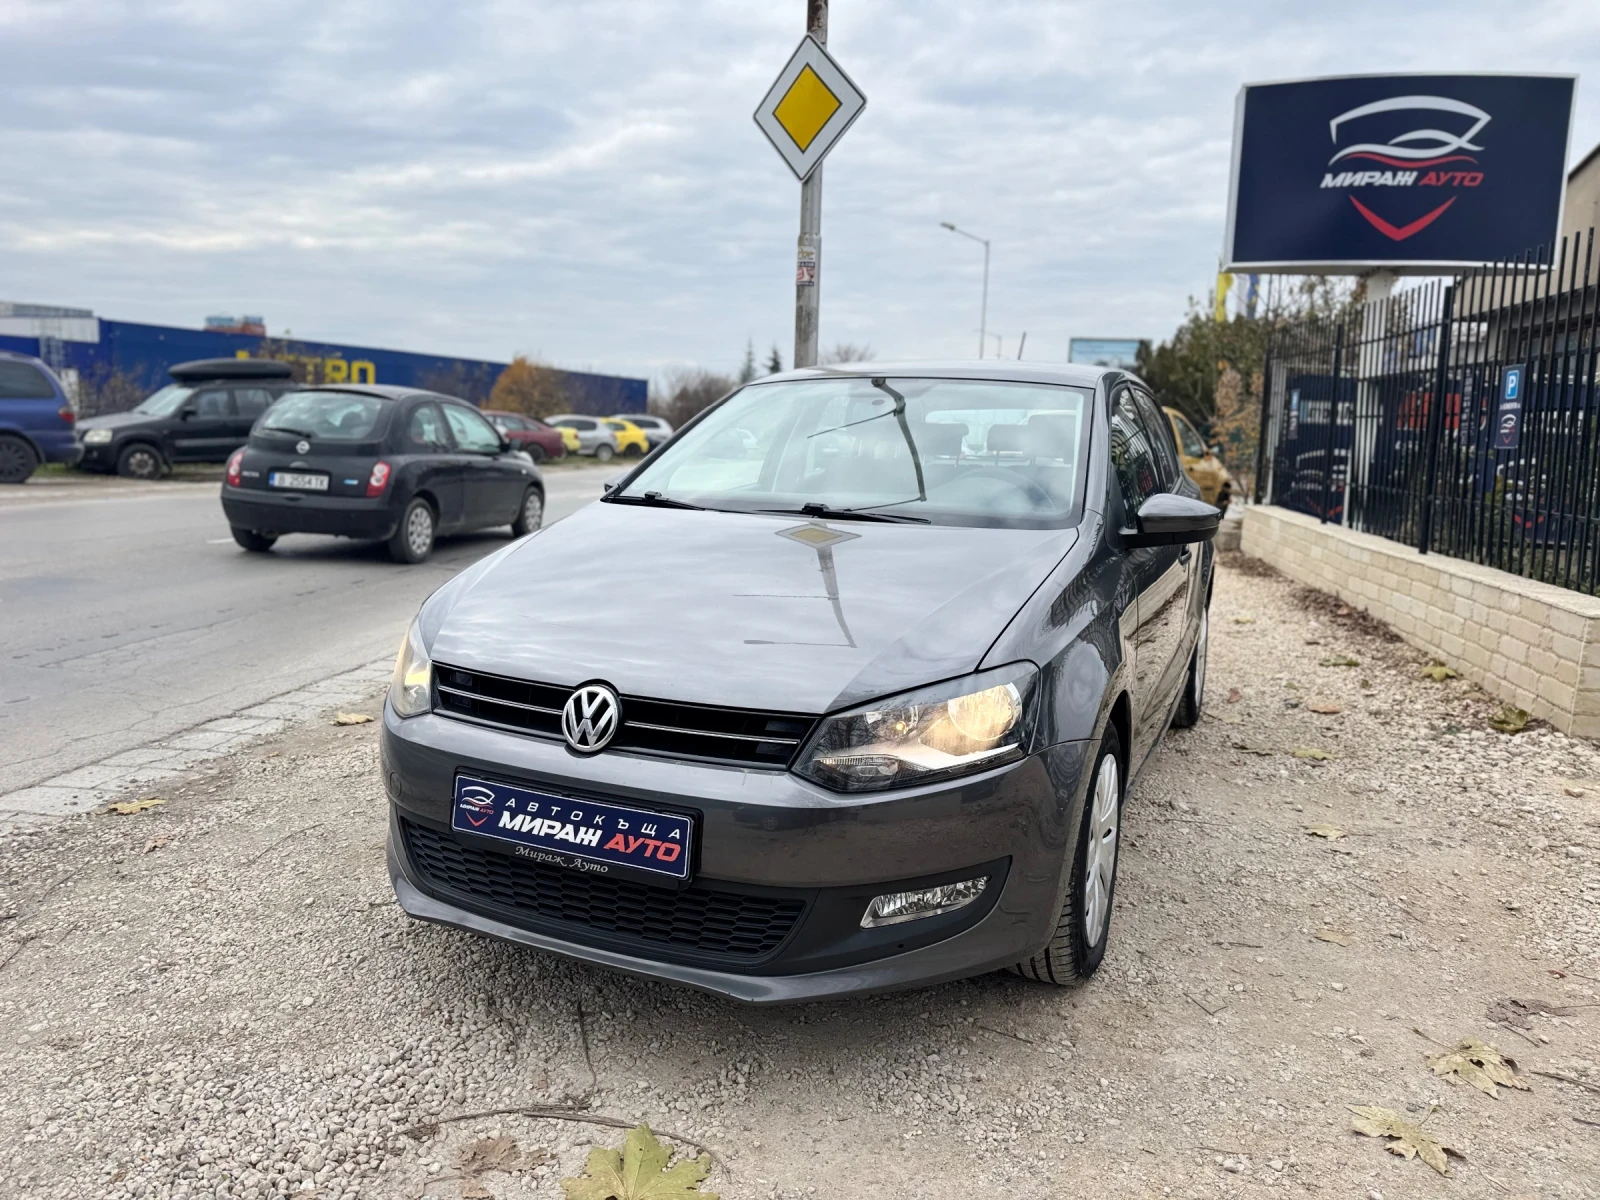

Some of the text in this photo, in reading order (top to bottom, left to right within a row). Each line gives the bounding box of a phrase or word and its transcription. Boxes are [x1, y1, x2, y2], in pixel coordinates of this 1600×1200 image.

[1320, 171, 1484, 189] МИРАЖ АУТО
[505, 798, 681, 839] АВТОКЪЩА
[498, 810, 681, 862] МИРАЖ АУТО
[515, 845, 609, 873] Мираж Ауто
